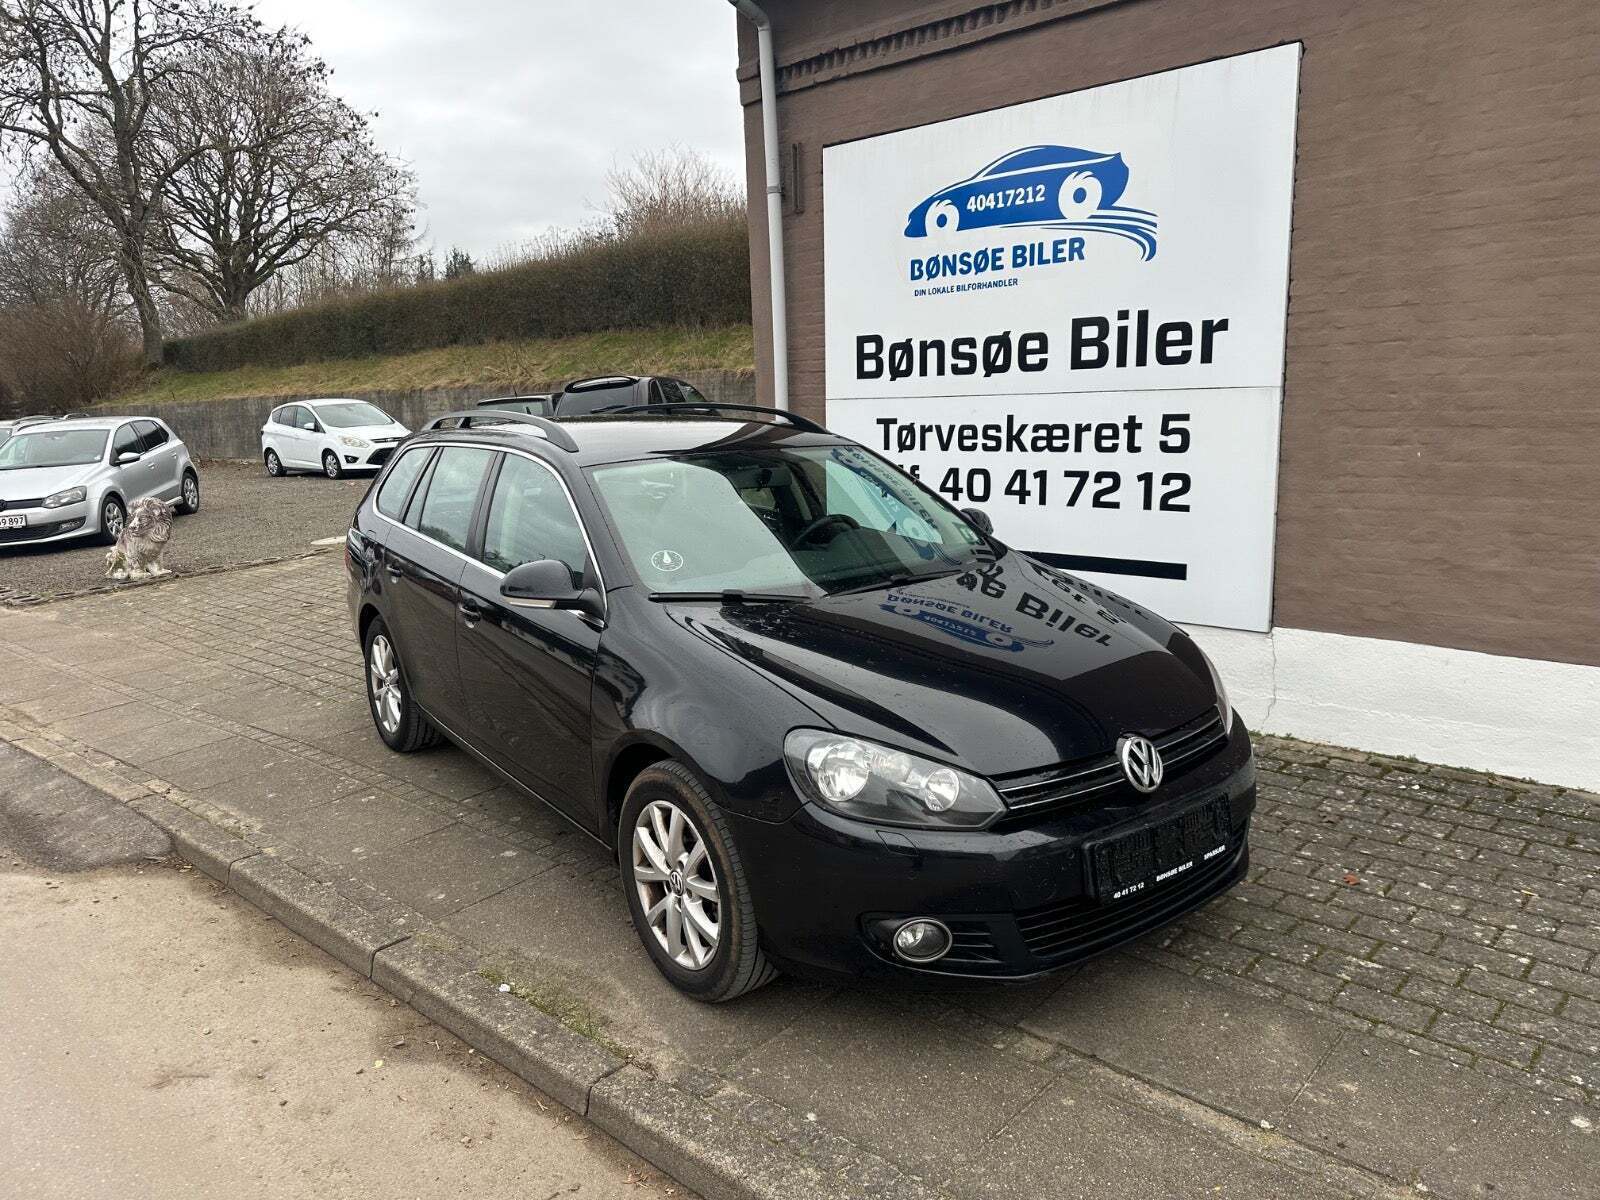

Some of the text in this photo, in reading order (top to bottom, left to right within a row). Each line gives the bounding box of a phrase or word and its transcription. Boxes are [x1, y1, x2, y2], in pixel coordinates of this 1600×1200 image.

[966, 184, 1046, 213] 40417212
[910, 236, 1086, 281] BØNSØE BILER
[914, 278, 1019, 297] DIN LOKALE BILFORHANDLER
[856, 309, 1230, 382] Bønsøe Biler
[876, 413, 1191, 454] Tørveskæret 5
[939, 467, 992, 503] 40
[1004, 468, 1048, 506] 41
[1063, 470, 1122, 510] 72
[1136, 471, 1192, 513] 12
[8, 517, 24, 526] 897
[1113, 891, 1121, 899] 40
